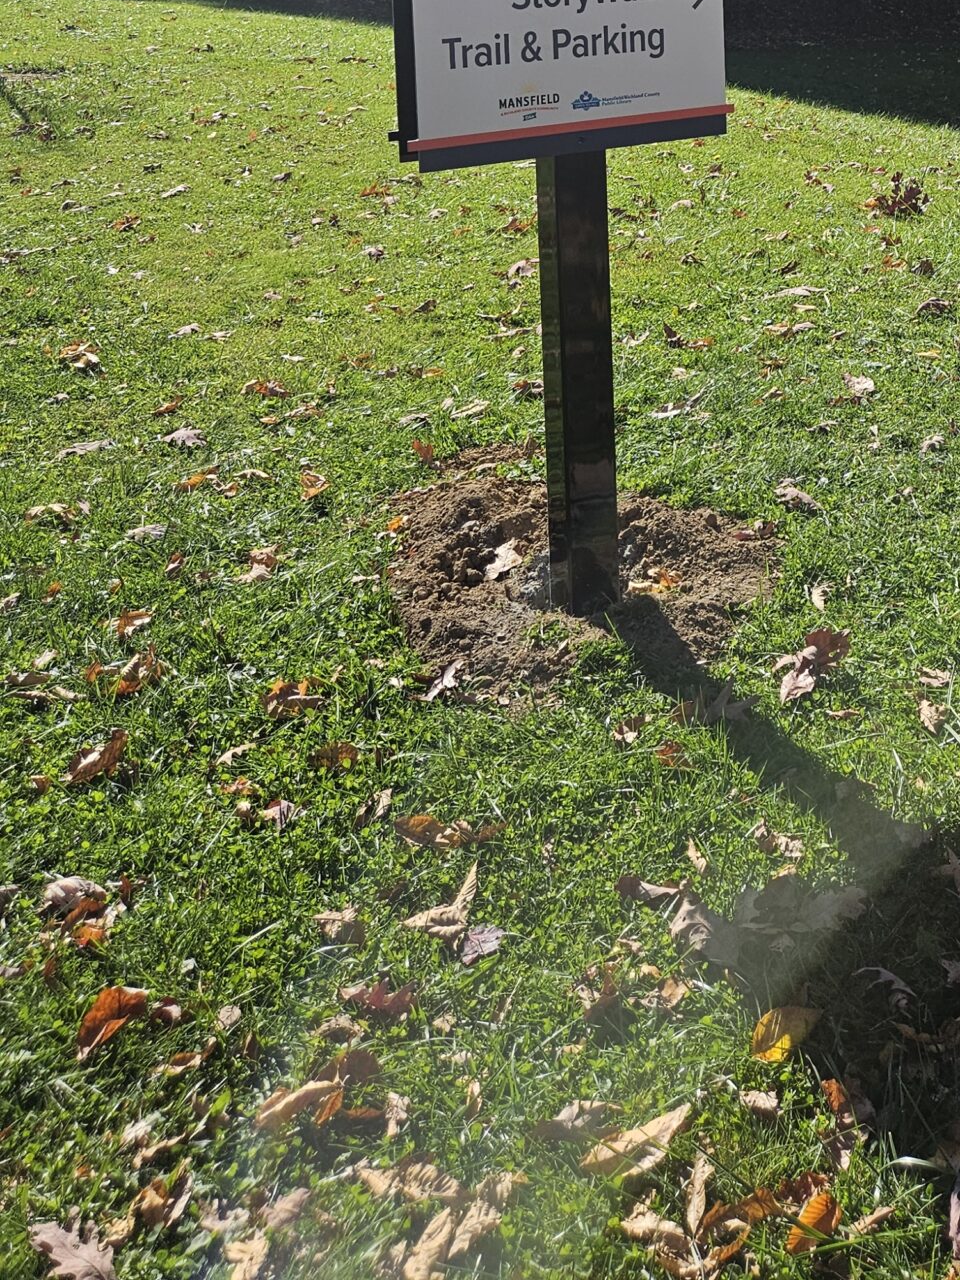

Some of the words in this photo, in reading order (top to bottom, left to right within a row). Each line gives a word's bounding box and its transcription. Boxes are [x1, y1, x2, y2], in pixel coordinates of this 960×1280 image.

[441, 33, 510, 70] Trail
[520, 30, 543, 63] &
[552, 23, 665, 59] Parking
[499, 93, 560, 109] MANSFIELD
